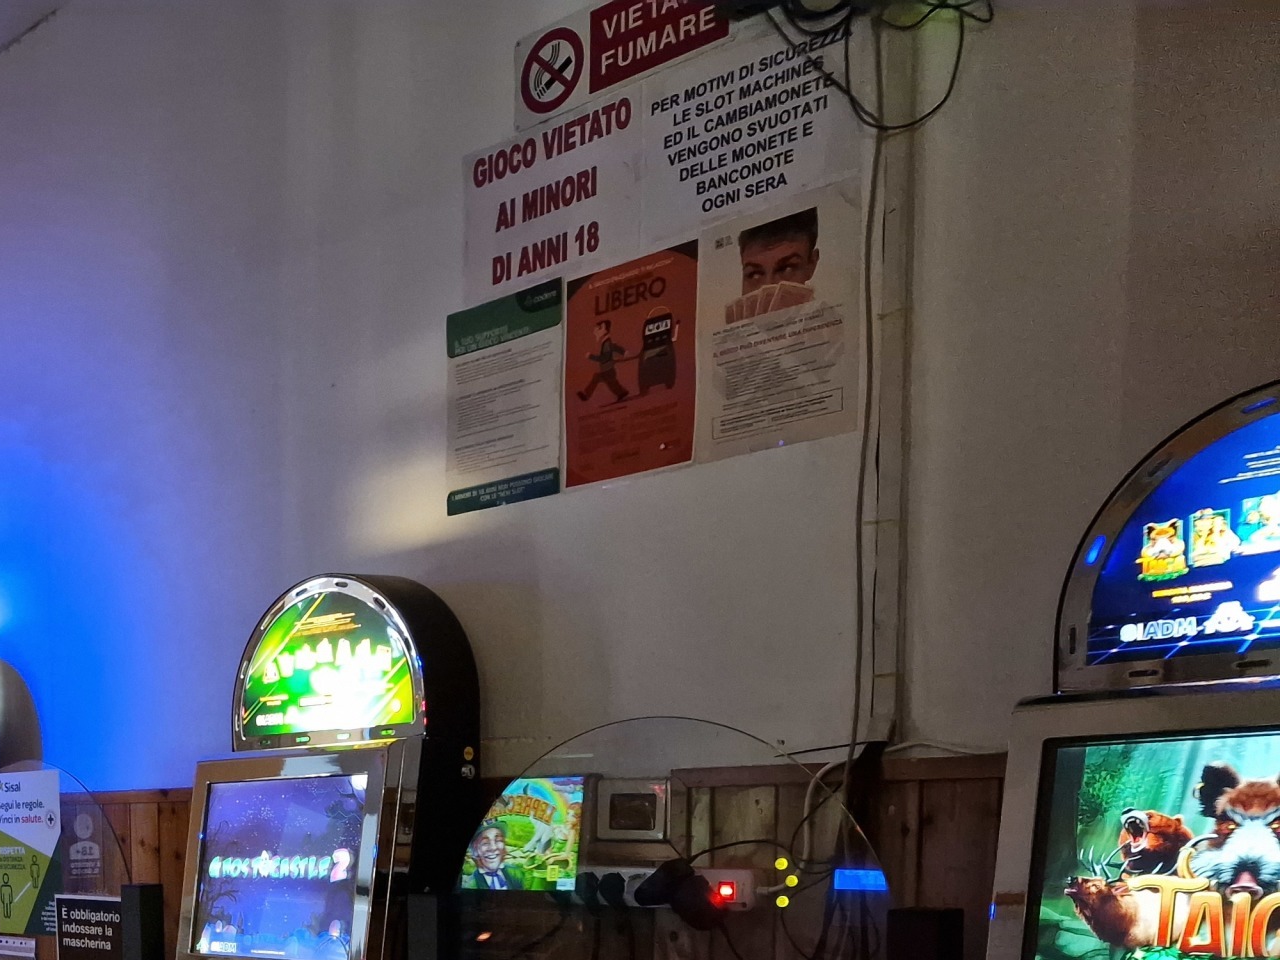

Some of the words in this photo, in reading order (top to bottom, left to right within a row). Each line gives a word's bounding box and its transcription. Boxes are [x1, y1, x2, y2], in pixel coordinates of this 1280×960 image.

[600, 4, 716, 76] FUMARE
[602, 0, 688, 39] VIETA
[650, 92, 680, 116] PER
[683, 69, 735, 102] MOTIVI
[738, 63, 754, 82] DI
[663, 129, 683, 150] ED
[687, 124, 700, 141] IL
[704, 71, 834, 133] CAMBIAMONETE
[672, 106, 691, 127] LE
[694, 89, 735, 118] SLOT
[738, 54, 825, 100] MACHINES
[473, 137, 537, 188] GIOCO
[542, 97, 632, 160] VIETATO
[667, 126, 742, 167] VENGONO
[746, 94, 829, 137] SVUOTATI
[679, 153, 727, 183] DELLE
[731, 127, 798, 164] MONETE
[802, 120, 814, 138] E
[695, 149, 794, 196] BANCONOTE
[701, 190, 741, 214] OGNI
[744, 172, 788, 199] SERA
[495, 197, 516, 233] AI
[522, 165, 598, 223] MINORI
[492, 251, 512, 286] DI
[517, 231, 568, 278] ANNI
[574, 220, 600, 257] 18
[594, 275, 667, 317] LIBERO
[1145, 617, 1197, 637] ADM
[4, 780, 21, 792] Sisal
[15, 801, 20, 809] le
[21, 800, 45, 811] regole.
[14, 815, 20, 823] in
[21, 814, 44, 824] salute.
[269, 855, 332, 880] CASTLE
[330, 848, 351, 882] 2
[62, 905, 68, 918] È
[70, 909, 120, 923] obbligatorio
[62, 922, 103, 935] indossare
[105, 925, 113, 936] la
[63, 936, 111, 950] mascherina
